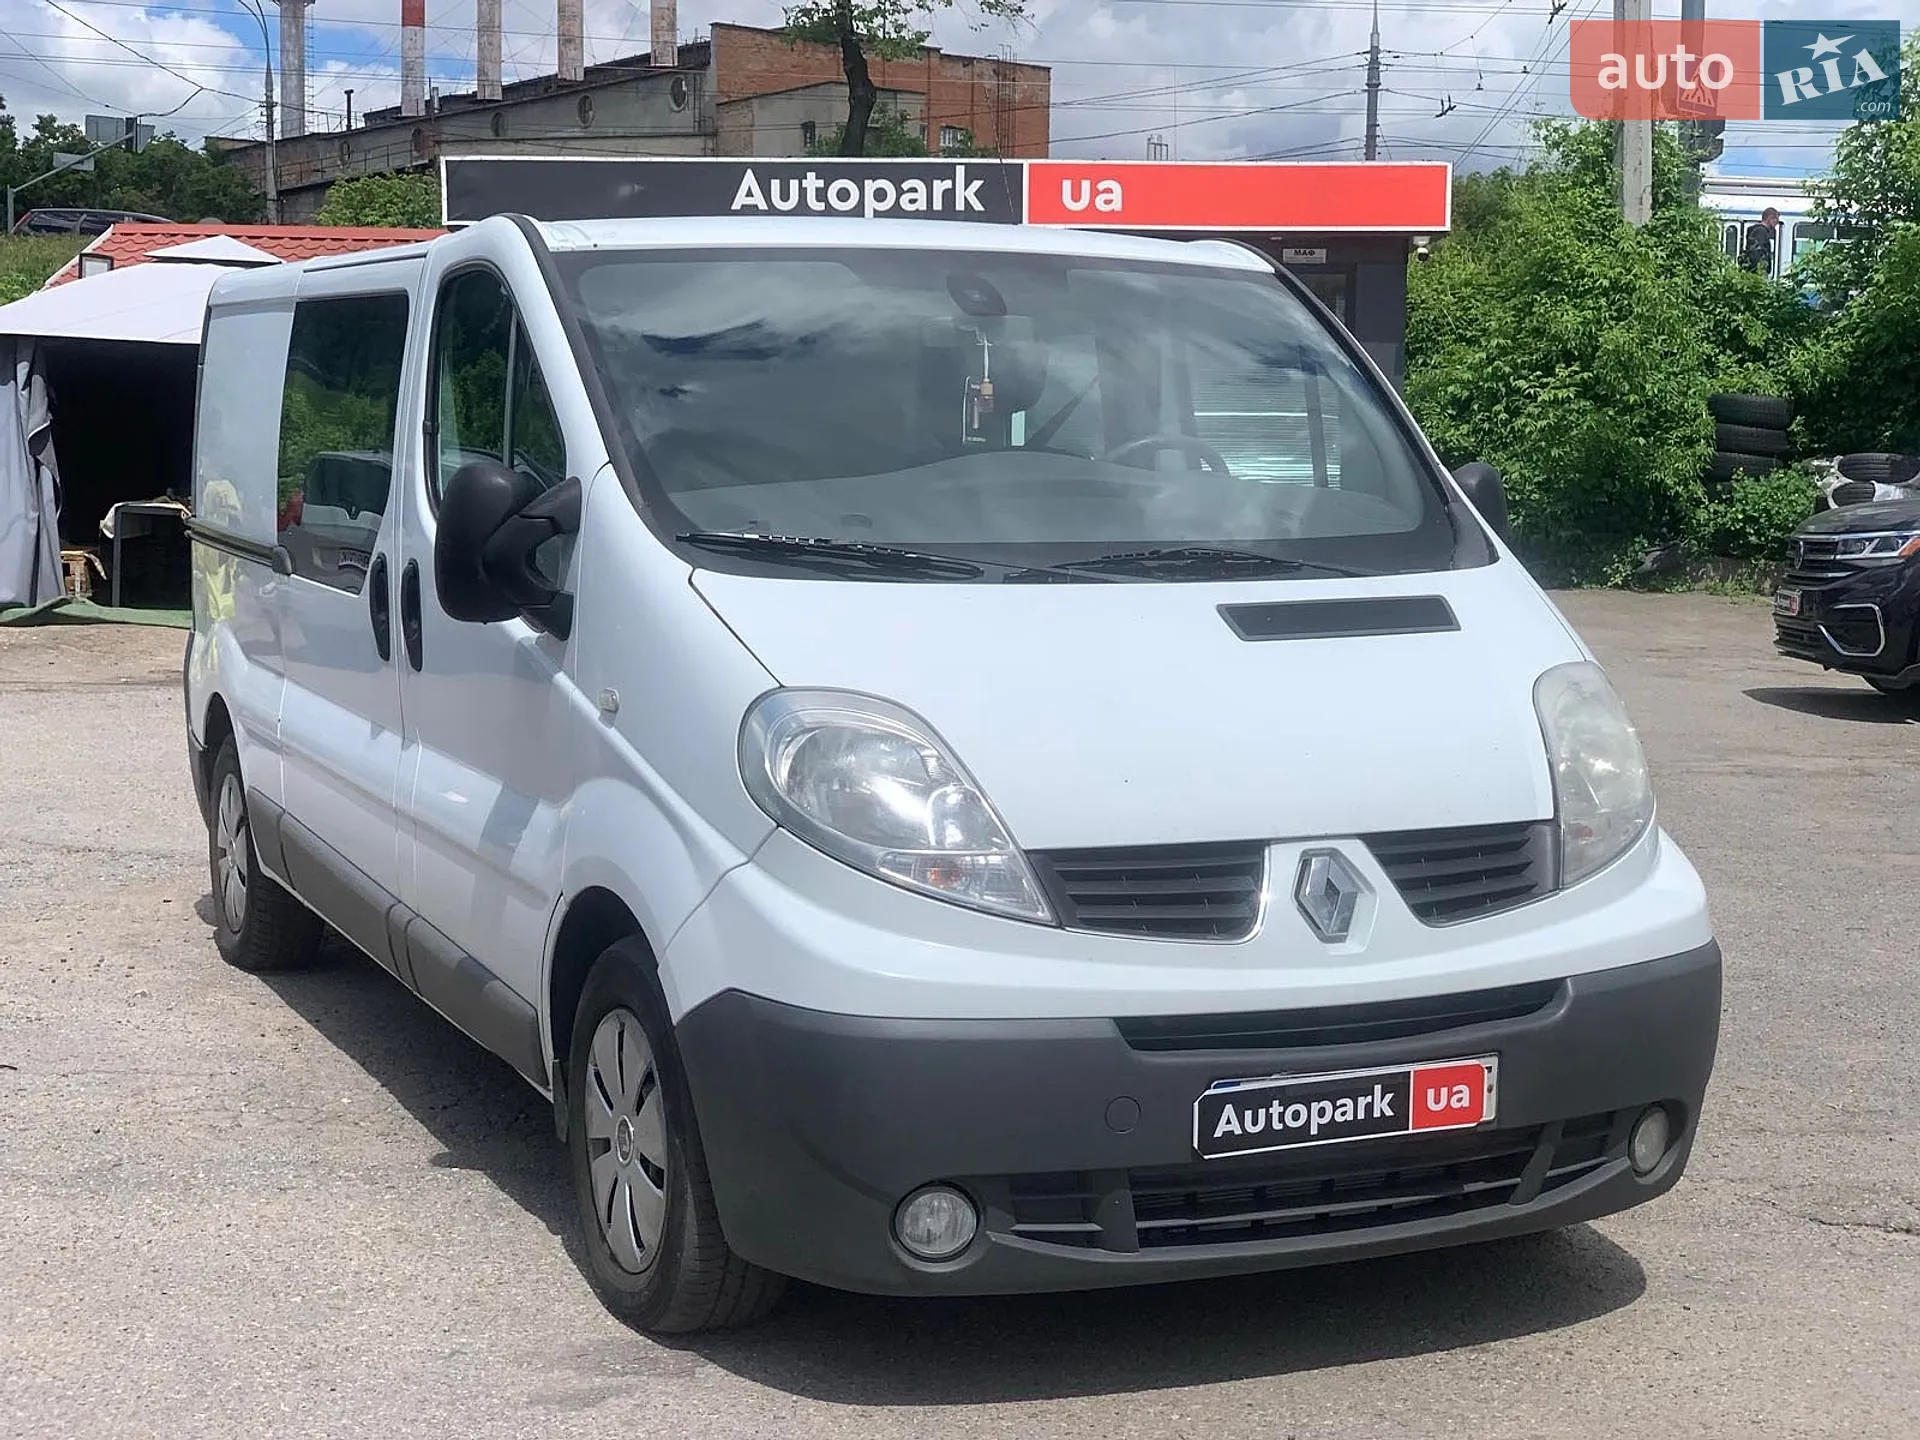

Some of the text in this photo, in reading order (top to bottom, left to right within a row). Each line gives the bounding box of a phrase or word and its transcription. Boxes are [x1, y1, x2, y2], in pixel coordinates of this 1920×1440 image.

[731, 165, 1122, 218] Autopark ua
[1213, 1083, 1471, 1135] Autopark ua
